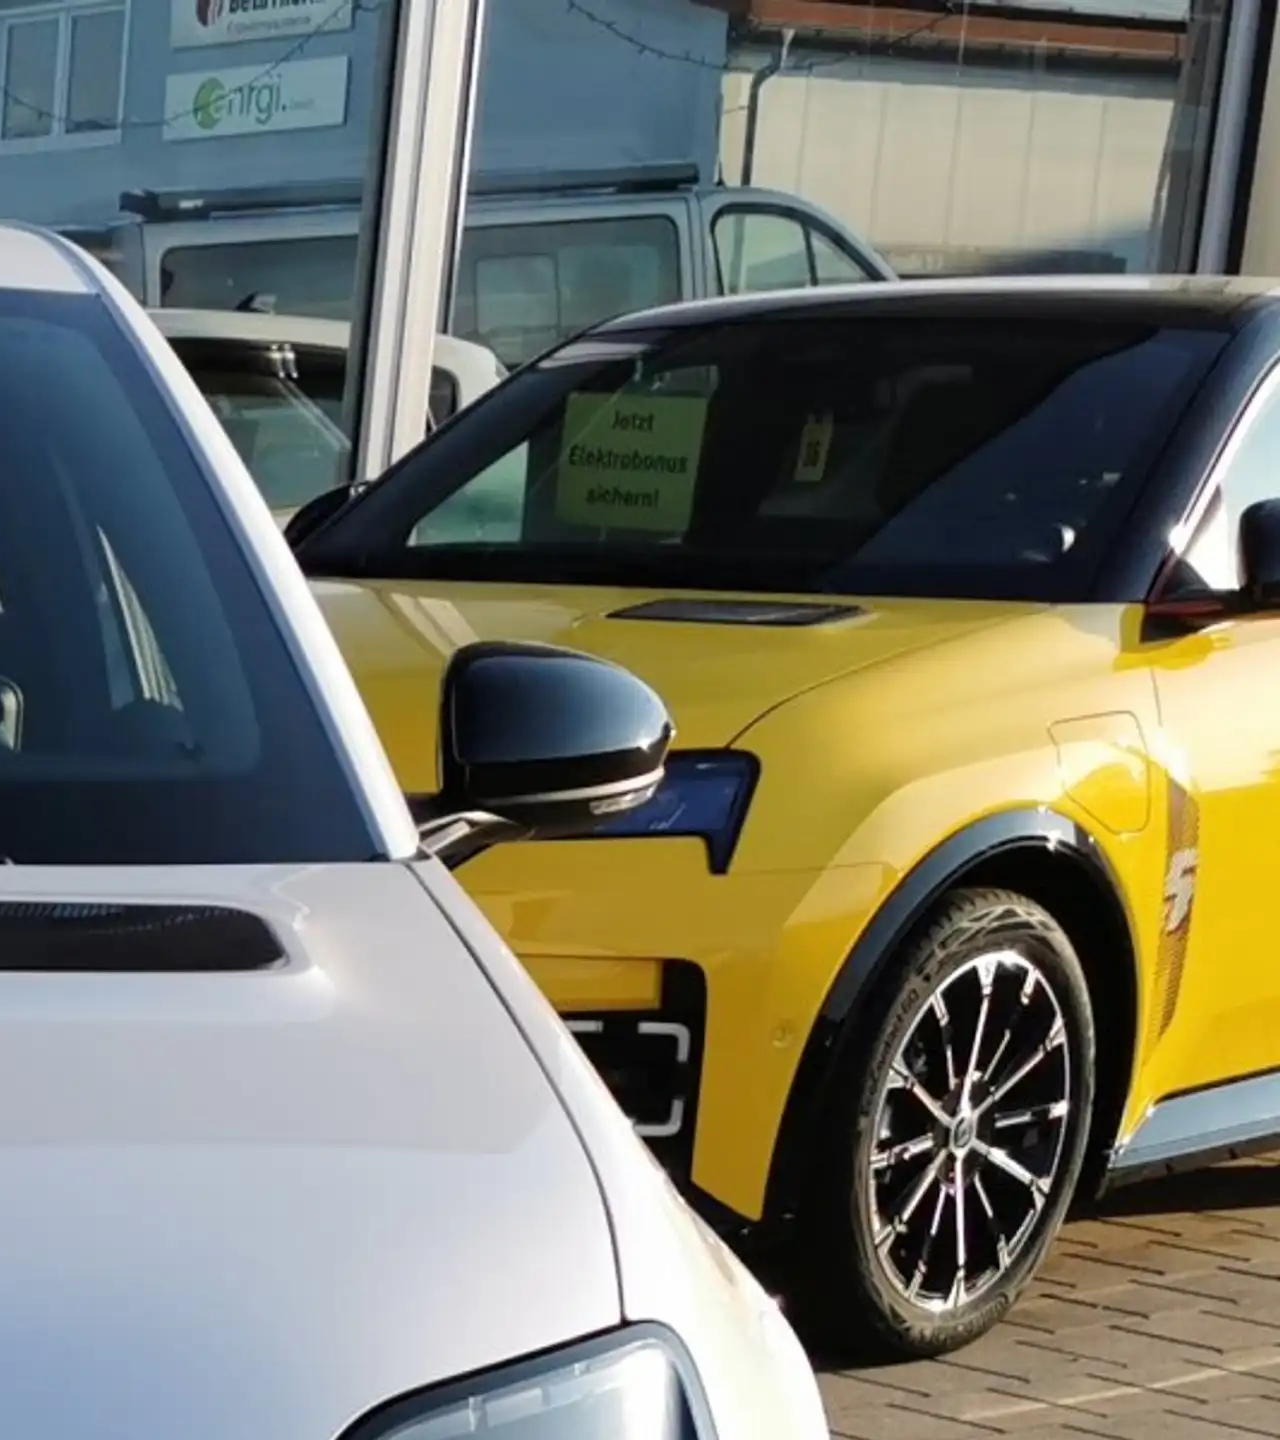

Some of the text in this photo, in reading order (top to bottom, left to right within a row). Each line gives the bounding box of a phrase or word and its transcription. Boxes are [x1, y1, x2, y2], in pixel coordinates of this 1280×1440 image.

[611, 410, 655, 432] Jetzt
[568, 444, 689, 474] Elektrobonus
[586, 484, 660, 509] sichern!
